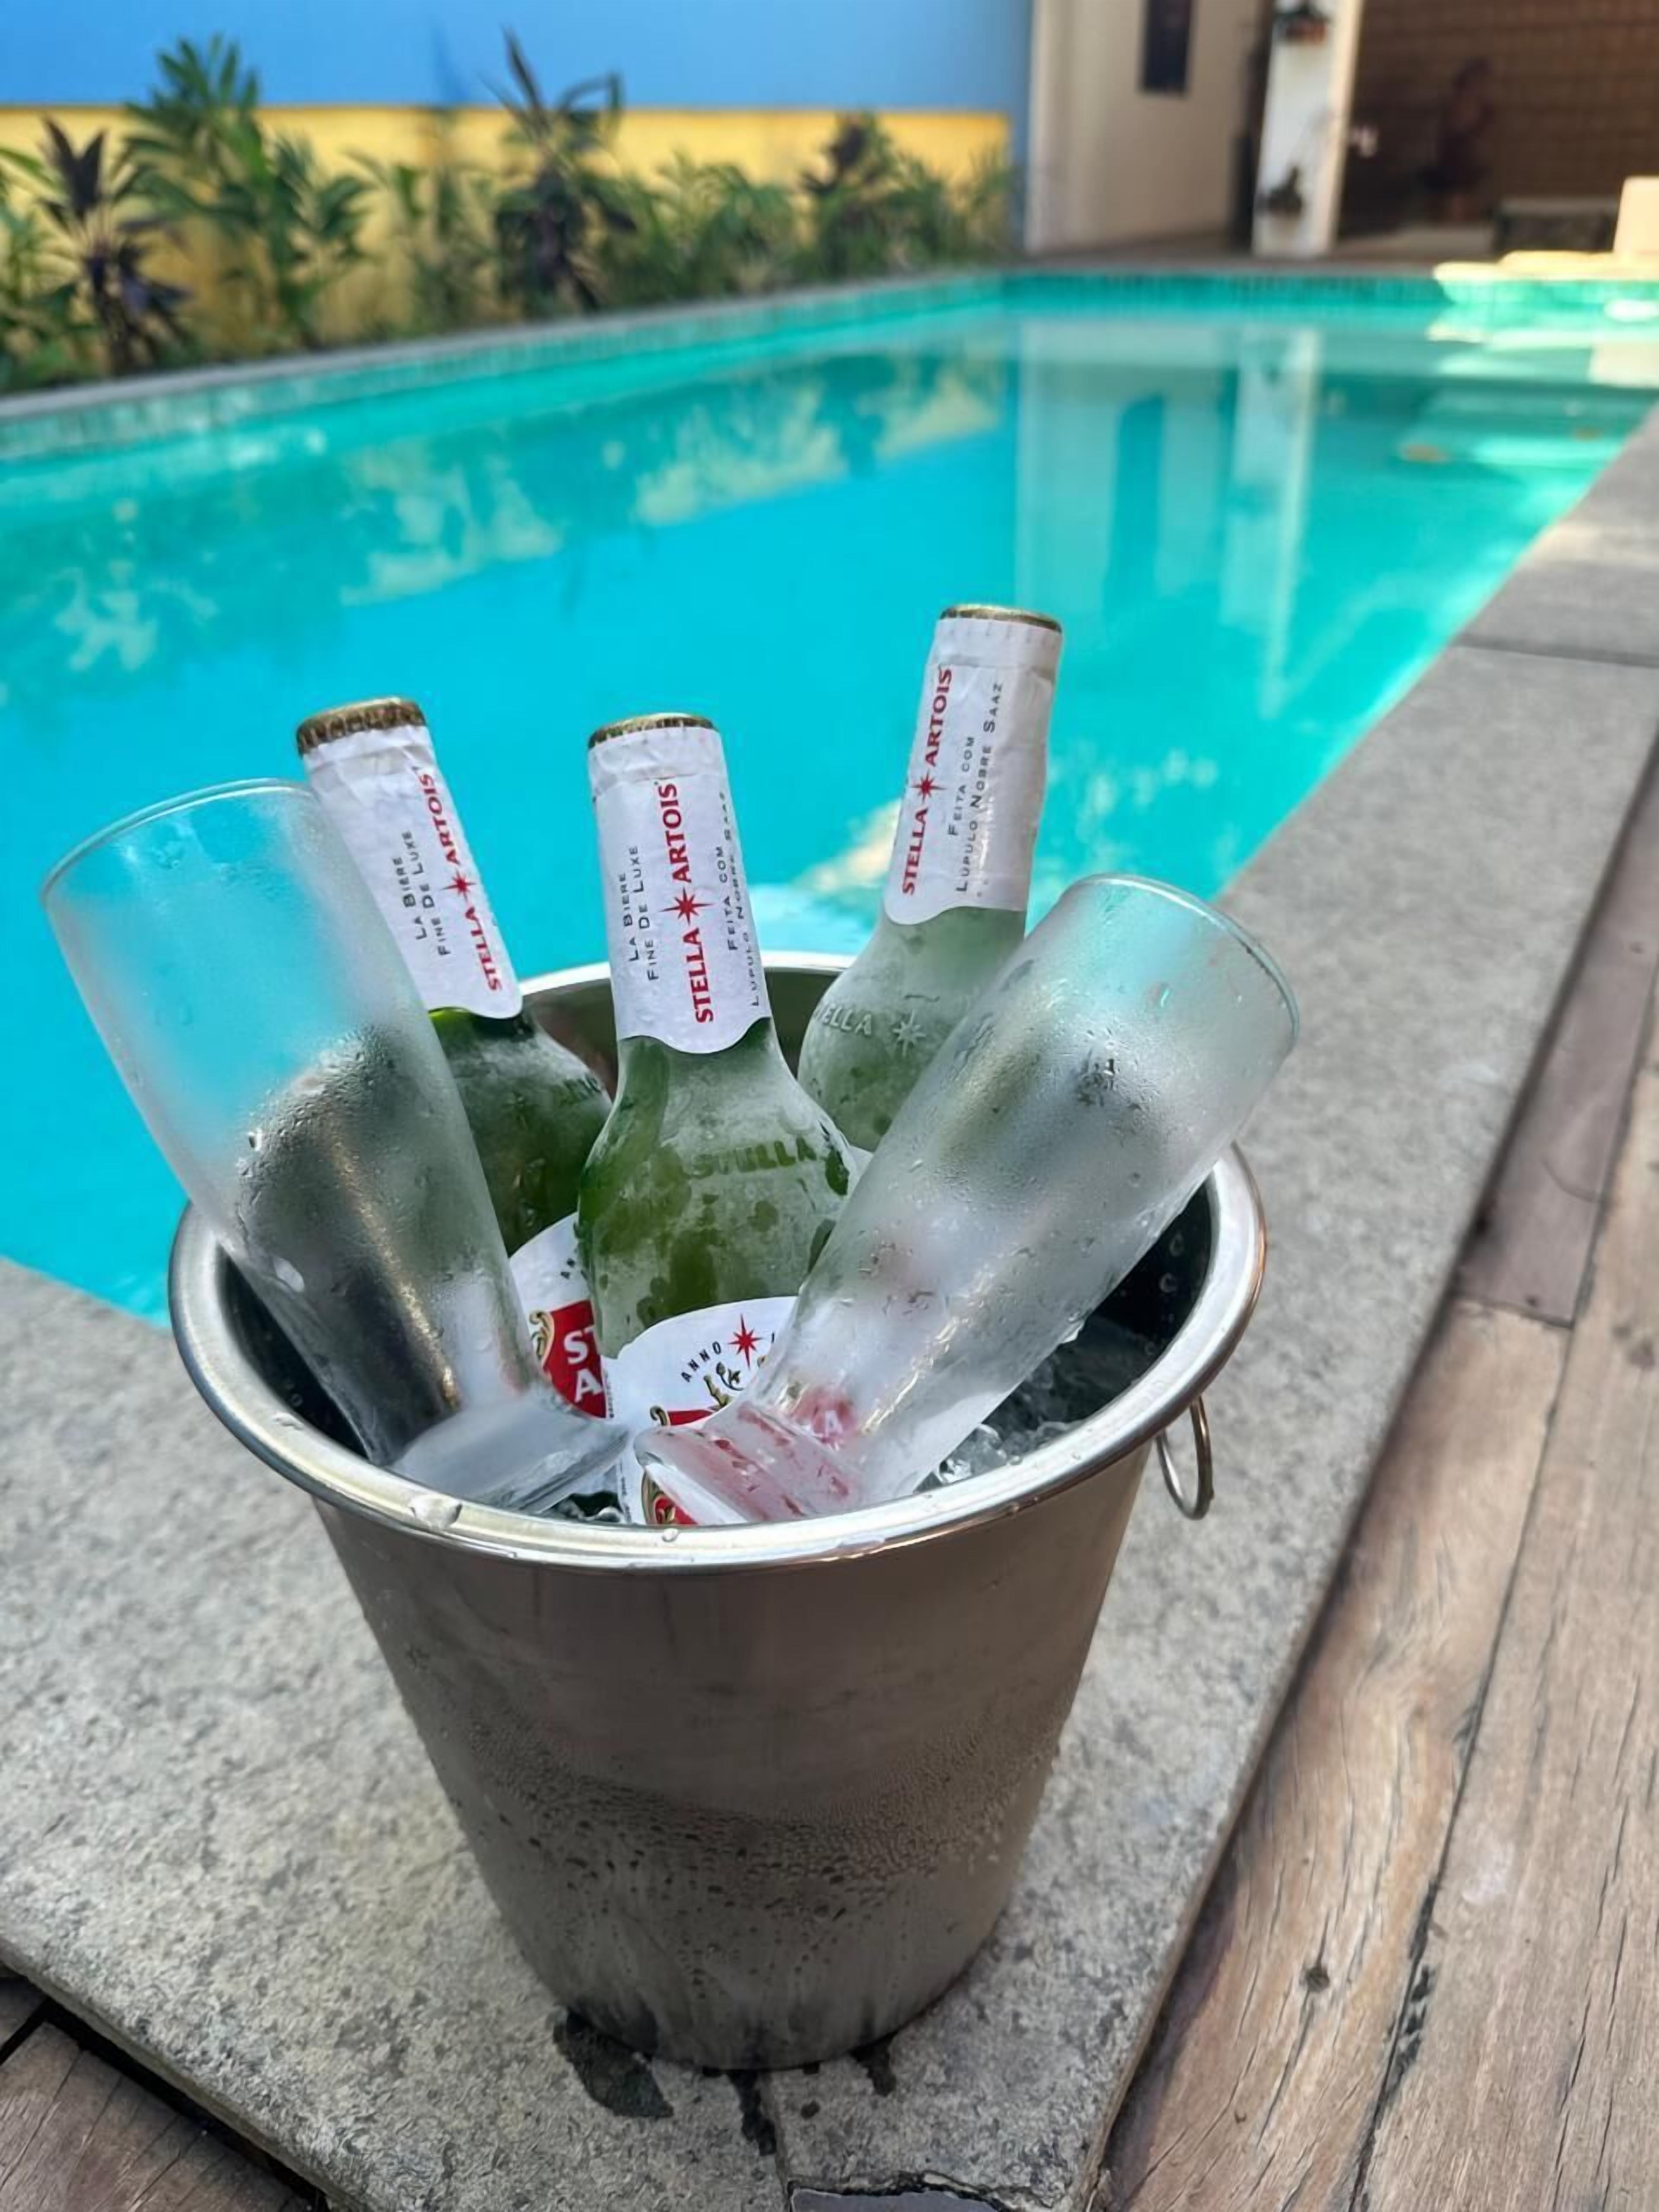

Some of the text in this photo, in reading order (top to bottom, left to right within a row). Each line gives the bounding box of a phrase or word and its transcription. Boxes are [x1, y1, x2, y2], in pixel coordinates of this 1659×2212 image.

[903, 668, 953, 896] STELLA ARTOIS
[970, 746, 992, 808] NOBRE
[983, 683, 1002, 733] SAAZ
[948, 785, 966, 836] FEITA
[402, 830, 451, 957] FINE DE LUXE
[414, 915, 427, 940] LA
[419, 774, 502, 991] STELLA ARTOIS
[629, 845, 659, 980] FINE DE LUXE
[658, 783, 714, 1023] STELLA ARTOIS
[724, 896, 738, 950] FEITA
[628, 936, 639, 962] LA
[681, 1341, 721, 1382] ANNO
